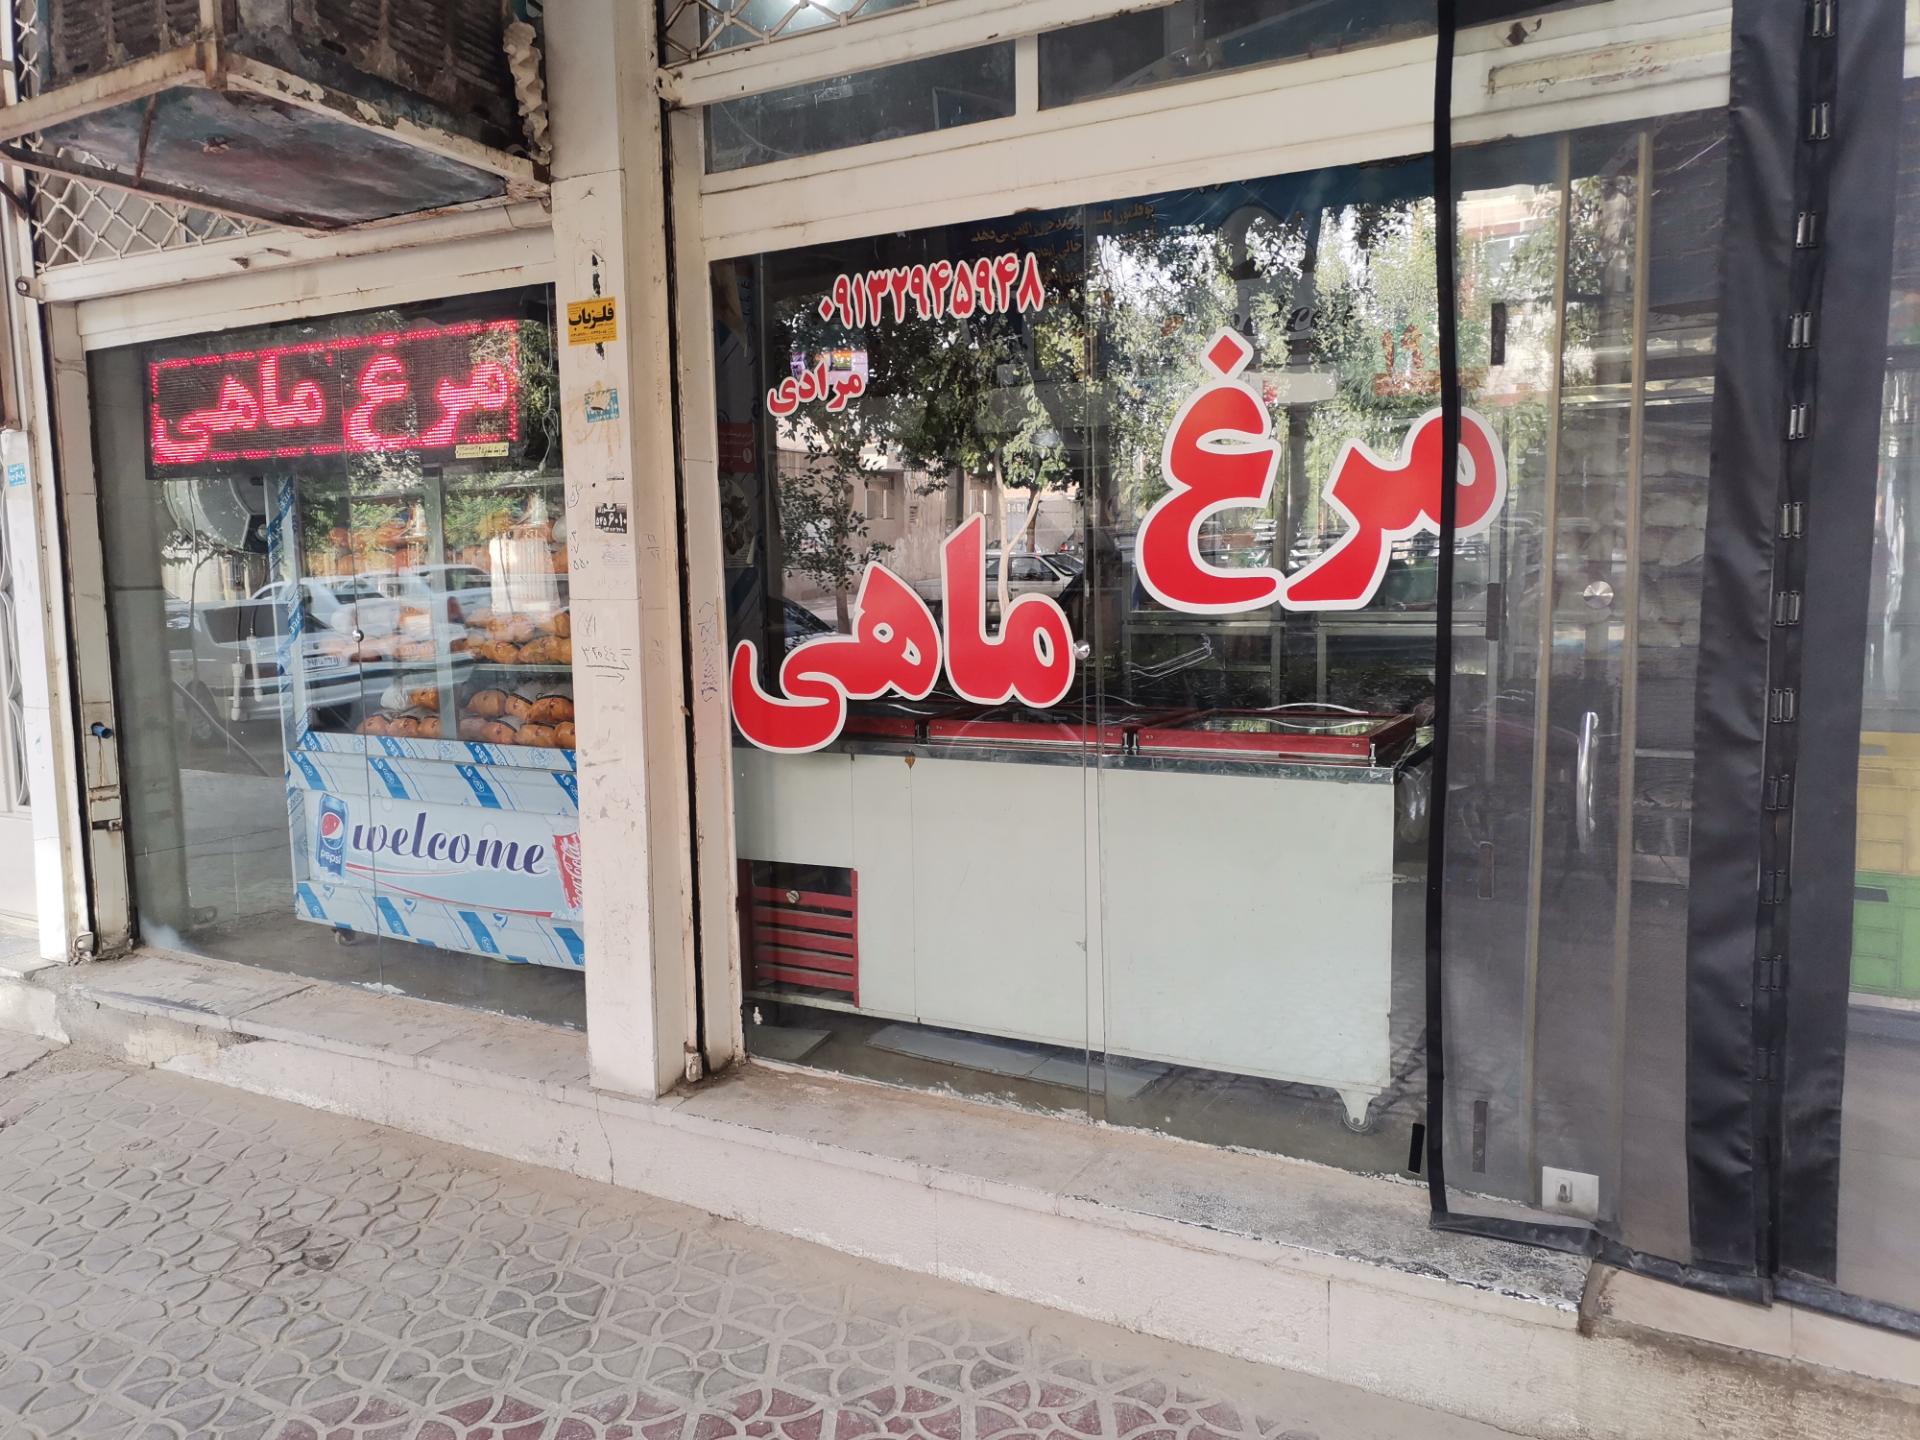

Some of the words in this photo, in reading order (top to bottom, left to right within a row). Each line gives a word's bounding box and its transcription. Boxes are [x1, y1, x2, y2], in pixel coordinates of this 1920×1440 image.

[569, 302, 614, 331] فلزیاب
[818, 252, 1044, 329] ۰۹۱۳۲۹۴۵۹۴۸
[152, 353, 326, 463] ماهی
[346, 338, 509, 447] مرغ
[767, 360, 866, 416] مرادی
[1136, 327, 1507, 614] مرغ
[729, 511, 1077, 754] ماهی
[320, 849, 341, 864] pepsi
[352, 811, 550, 875] welcome
